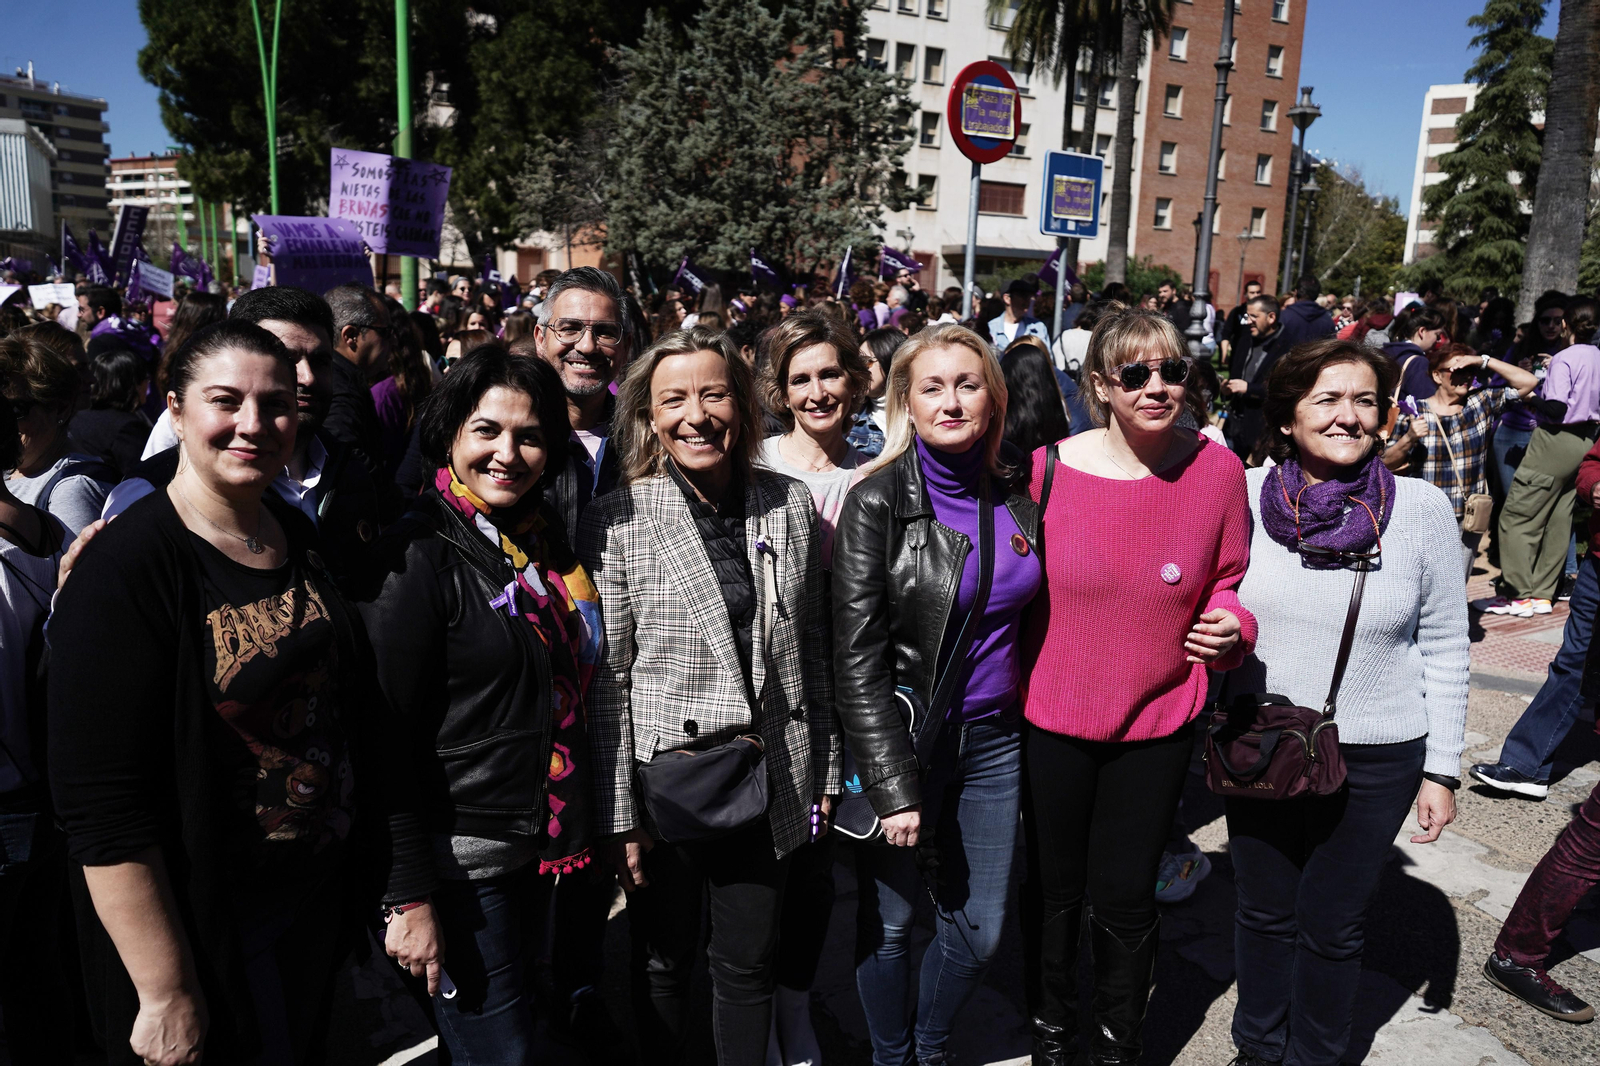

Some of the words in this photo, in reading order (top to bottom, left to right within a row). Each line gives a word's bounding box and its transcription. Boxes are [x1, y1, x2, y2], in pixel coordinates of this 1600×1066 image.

[979, 92, 998, 104] Plaza
[1002, 95, 1011, 105] de
[979, 106, 986, 117] la
[989, 109, 1011, 121] mujer
[968, 120, 1010, 134] trabajadora
[351, 162, 391, 181] SOMOS
[340, 181, 381, 199] NIETAS
[389, 187, 401, 201] DE
[405, 191, 426, 205] LAS
[338, 198, 390, 218] BRUJAS
[271, 222, 321, 238] VAMOS
[324, 223, 341, 238] A
[285, 239, 339, 254] ECHARLE
[340, 239, 360, 253] UN
